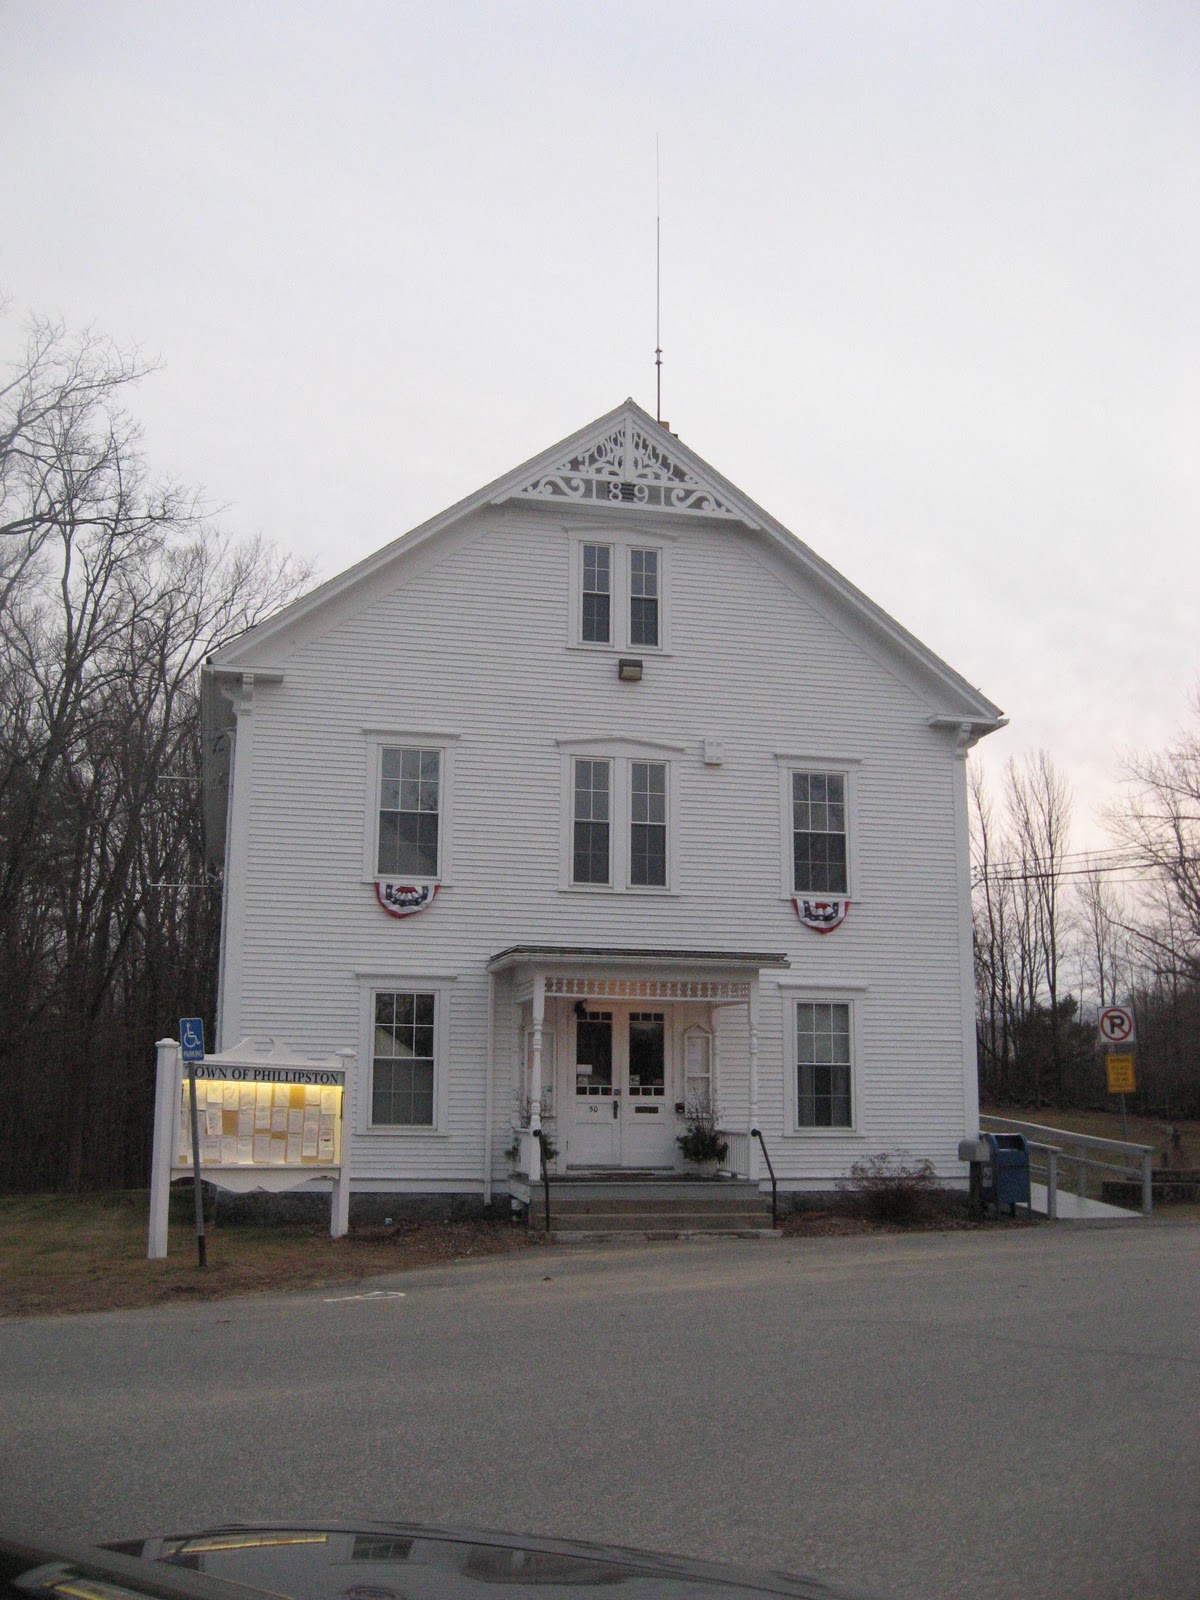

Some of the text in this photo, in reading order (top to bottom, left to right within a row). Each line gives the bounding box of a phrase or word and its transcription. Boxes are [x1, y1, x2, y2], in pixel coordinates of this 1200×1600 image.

[1107, 1014, 1125, 1034] P
[183, 1050, 203, 1058] PARKING
[231, 1068, 249, 1080] OF
[253, 1069, 340, 1084] PHILLIPSTON
